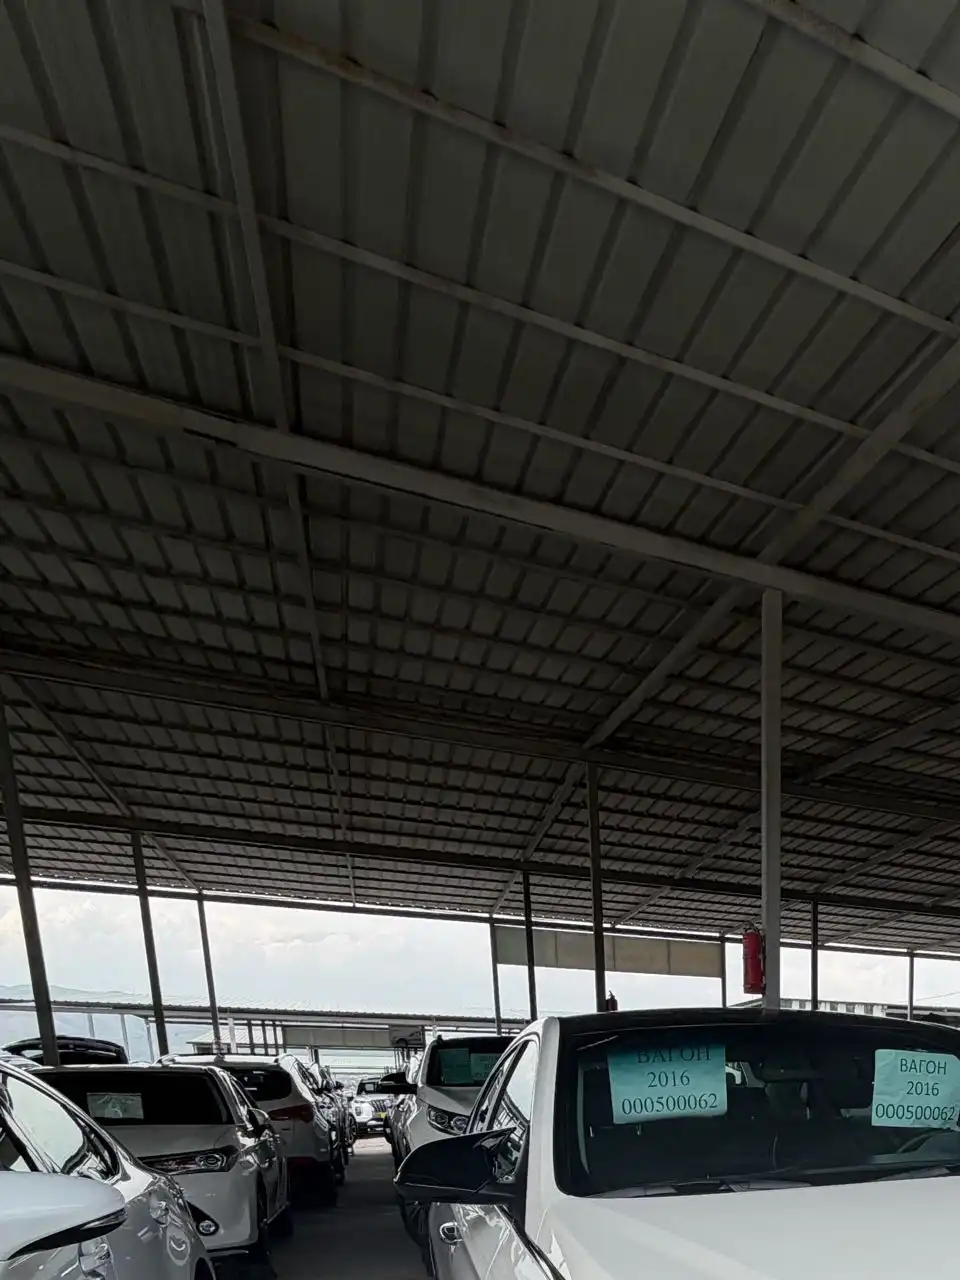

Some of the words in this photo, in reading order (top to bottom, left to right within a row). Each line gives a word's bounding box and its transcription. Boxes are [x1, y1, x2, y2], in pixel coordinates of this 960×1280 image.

[900, 1058, 947, 1075] ВАГОН
[648, 1070, 690, 1088] 2016
[906, 1081, 940, 1096] 2016
[622, 1093, 718, 1115] 000500062
[875, 1103, 955, 1121] 000500062
